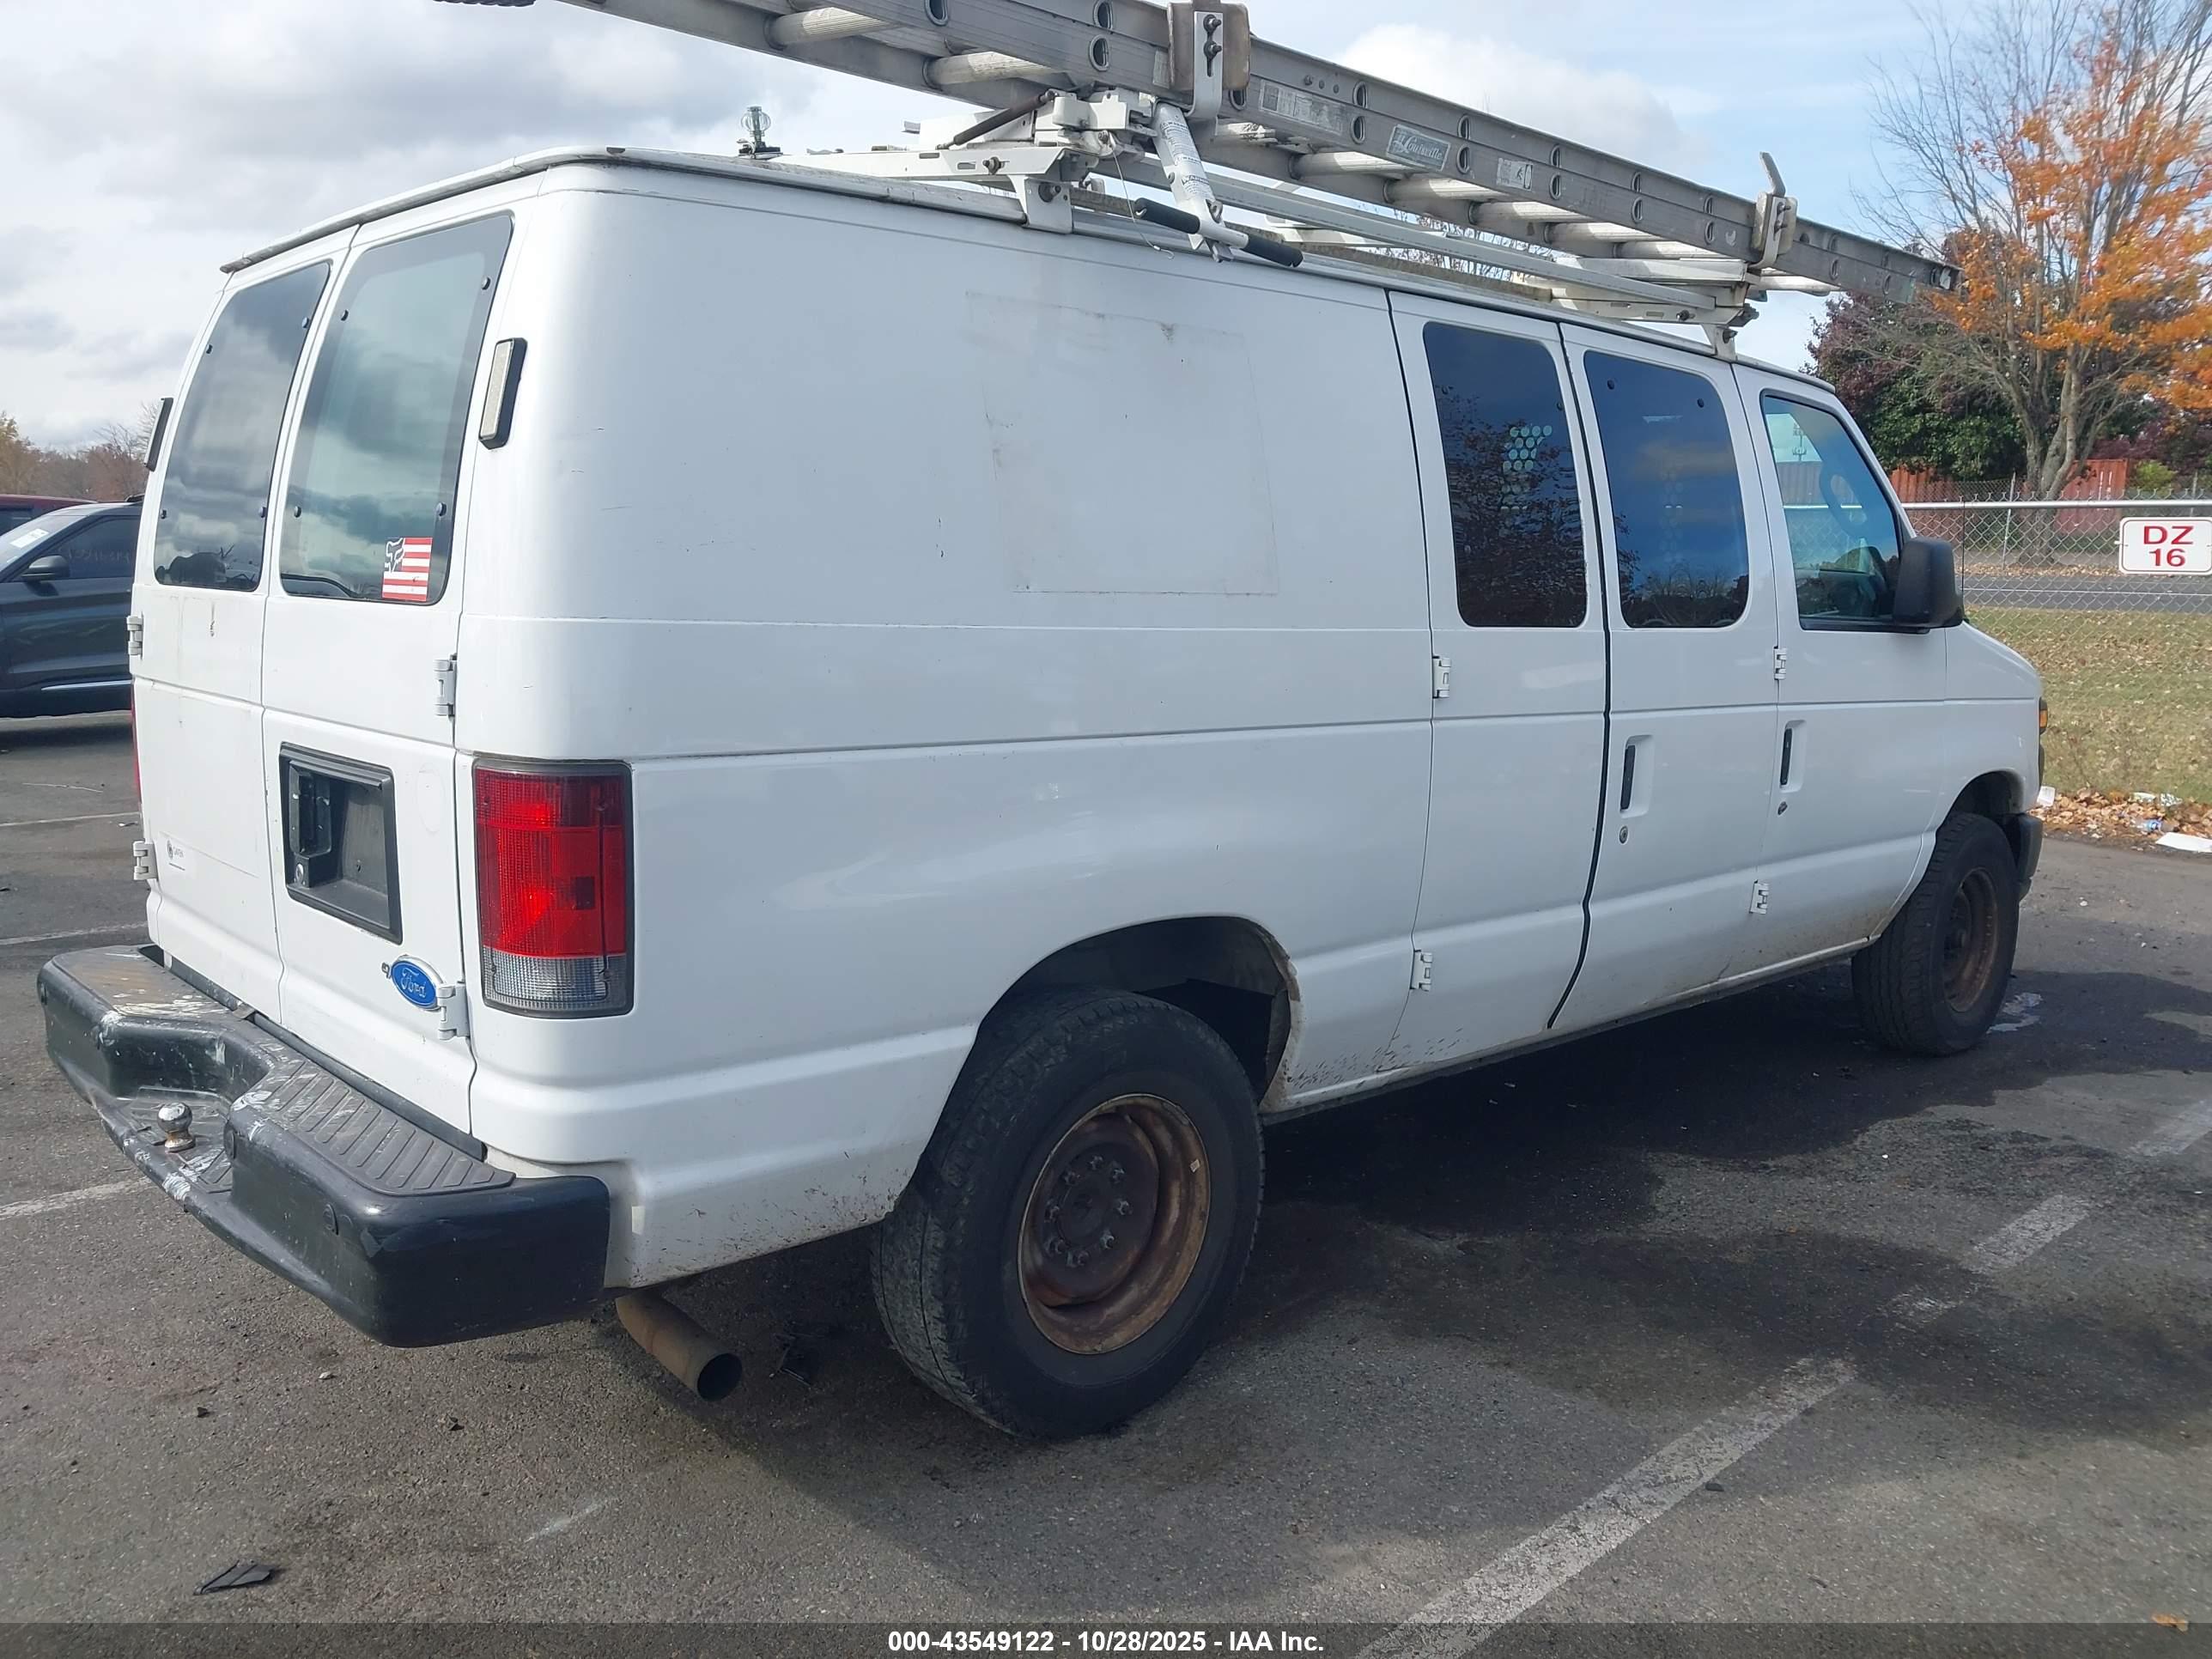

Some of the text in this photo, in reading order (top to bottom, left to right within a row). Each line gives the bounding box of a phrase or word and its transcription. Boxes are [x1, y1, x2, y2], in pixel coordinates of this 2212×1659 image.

[2143, 526, 2194, 545] DZ
[2148, 548, 2186, 568] 16
[401, 967, 428, 999] Ford
